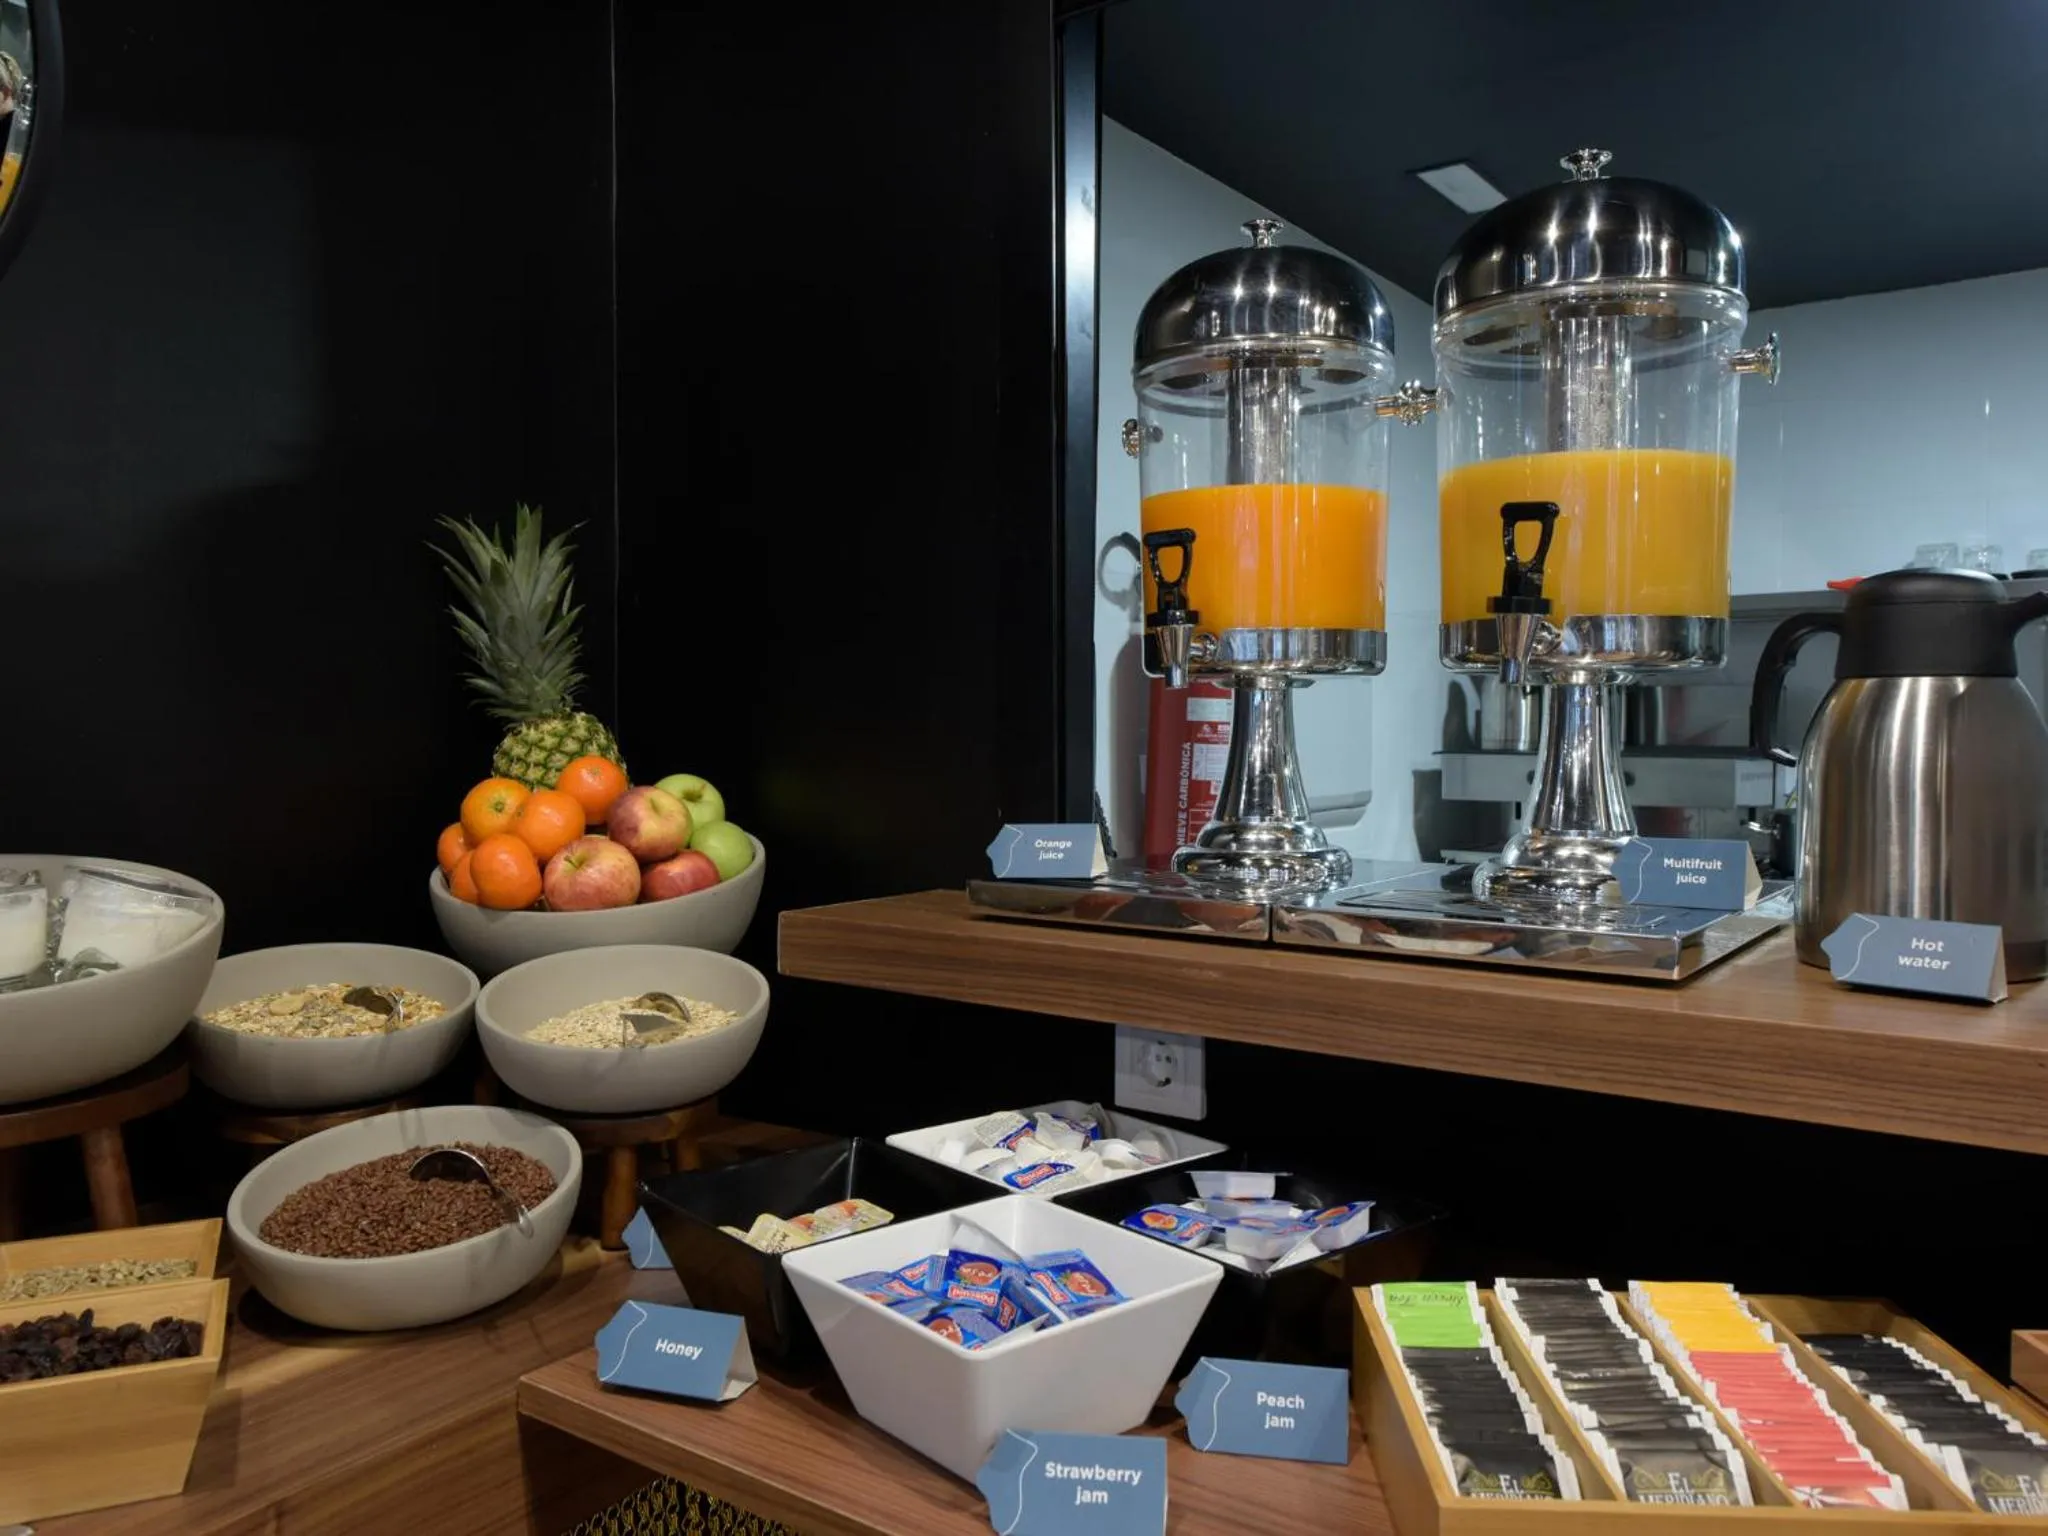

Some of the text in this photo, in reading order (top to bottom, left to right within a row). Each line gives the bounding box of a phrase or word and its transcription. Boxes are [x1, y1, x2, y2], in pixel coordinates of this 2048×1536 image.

[1035, 839, 1072, 849] Orange
[1039, 850, 1064, 861] juice
[1663, 857, 1723, 870] Multifruit
[1676, 872, 1707, 885] juice
[1911, 937, 1945, 952] Hot
[1898, 955, 1951, 970] water
[655, 1337, 704, 1361] Honey
[1256, 1391, 1305, 1409] Peach
[1264, 1411, 1295, 1430] jam
[1044, 1461, 1142, 1486] Strawberry
[1074, 1485, 1109, 1506] jam
